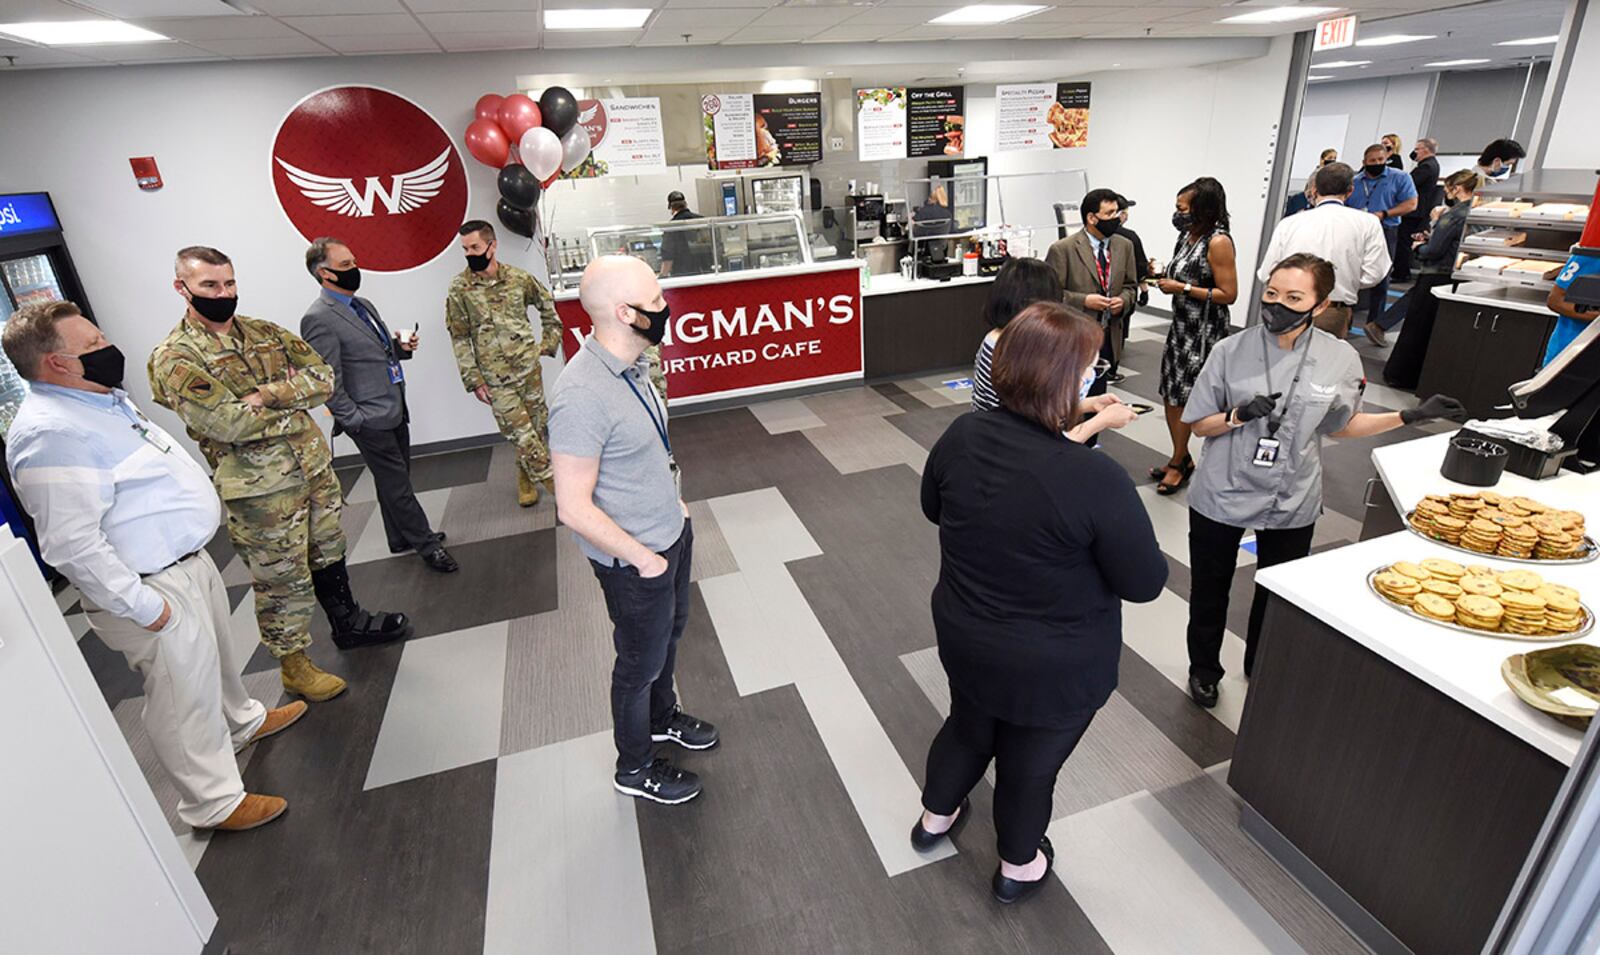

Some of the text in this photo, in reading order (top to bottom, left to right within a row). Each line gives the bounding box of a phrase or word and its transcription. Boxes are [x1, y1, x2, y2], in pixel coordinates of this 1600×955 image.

[1320, 19, 1351, 46] EXIT
[936, 90, 952, 98] GRILL
[661, 339, 822, 375] RTYARD CAFE
